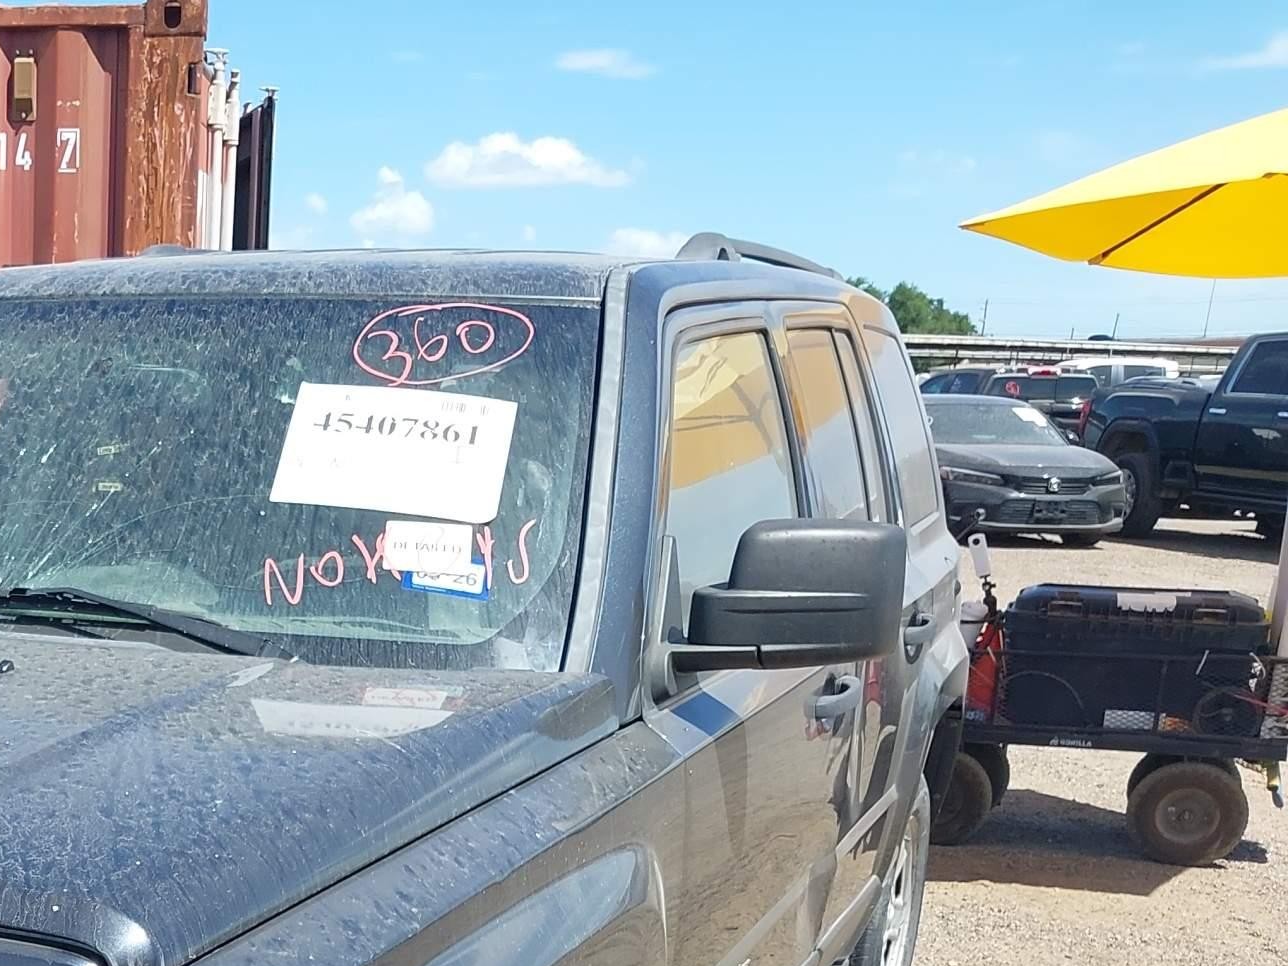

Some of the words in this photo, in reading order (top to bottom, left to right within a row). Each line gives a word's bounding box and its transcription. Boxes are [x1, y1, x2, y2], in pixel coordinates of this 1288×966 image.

[60, 132, 77, 169] 7
[367, 317, 496, 386] 360
[313, 412, 478, 445] 45407861
[351, 518, 537, 592] KYS
